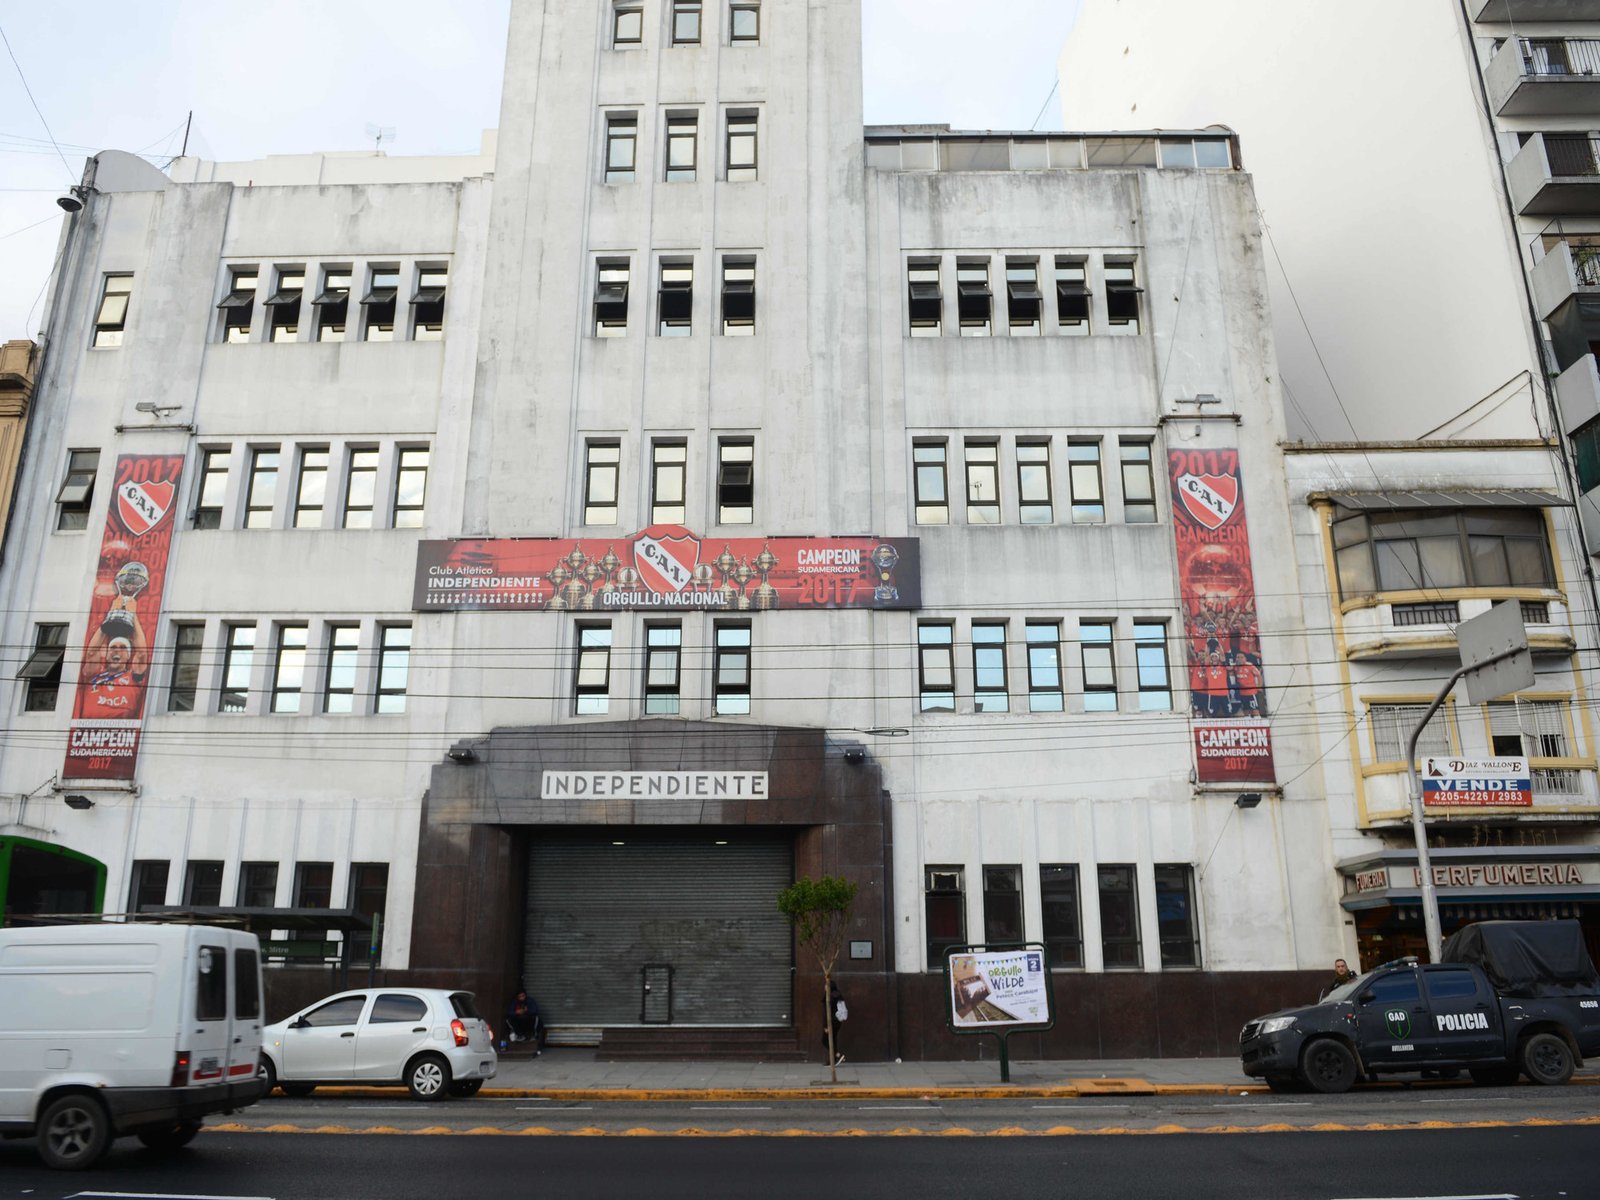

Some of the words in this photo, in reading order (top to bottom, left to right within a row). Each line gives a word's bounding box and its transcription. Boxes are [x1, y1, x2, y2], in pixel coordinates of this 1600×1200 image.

[1170, 450, 1238, 482] 2017
[114, 458, 183, 487] 2017
[797, 549, 860, 565] CAMPEON
[429, 566, 453, 575] Club
[428, 577, 541, 588] INDEPENDIENTE
[798, 573, 859, 604] 2017
[603, 592, 661, 605] ORGULLO
[664, 592, 728, 605] NACIONAL
[71, 729, 137, 747] CAMPEON
[1200, 729, 1268, 747] CAMPEON
[70, 748, 133, 756] SUDAMERICANA
[1201, 748, 1269, 757] SUDAMERICANA
[88, 757, 112, 769] 2017
[1224, 757, 1248, 769] 2017
[545, 775, 765, 795] INDEPENDIENTE
[1437, 779, 1518, 791] VENDE
[1434, 791, 1488, 800] 4205-4226
[1498, 791, 1523, 800] 2983
[1030, 960, 1038, 969] 2
[1388, 1012, 1406, 1022] GAD
[1436, 1012, 1489, 1031] POLICIA
